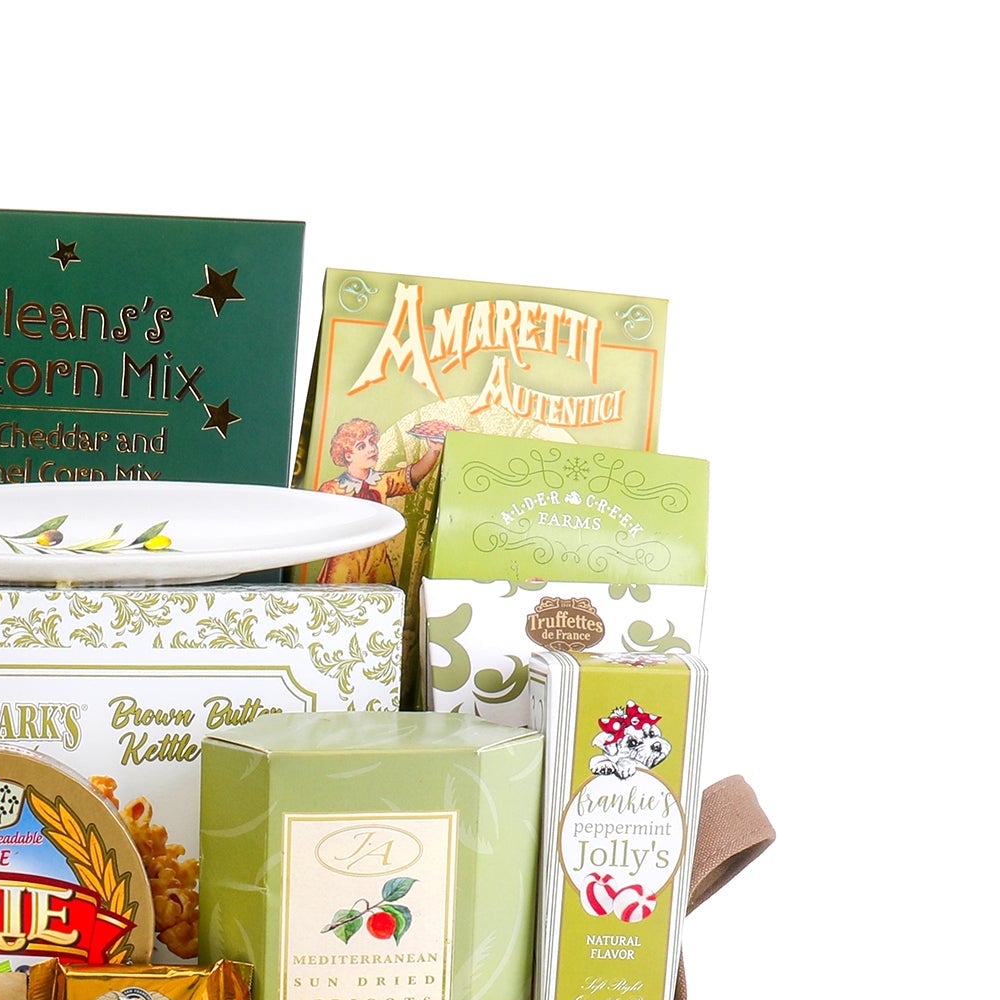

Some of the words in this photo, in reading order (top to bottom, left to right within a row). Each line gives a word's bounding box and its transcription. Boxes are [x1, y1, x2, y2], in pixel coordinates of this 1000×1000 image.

[347, 282, 602, 402] AMARETTI
[121, 350, 204, 401] Mix
[470, 355, 626, 427] AUTENTICI
[116, 427, 167, 454] and
[38, 461, 107, 482] Corn
[537, 512, 602, 530] FARMS
[528, 611, 604, 633] Truffettes
[542, 629, 554, 639] de
[556, 630, 591, 640] France
[108, 696, 195, 729] Brown
[203, 696, 282, 729] Butt
[119, 731, 202, 766] Kettle
[577, 786, 677, 818] frankie's
[573, 821, 672, 838] peppermint
[573, 839, 669, 876] Jolly's
[586, 935, 641, 947] NATURAL
[293, 953, 438, 966] MEDITERRANEAN
[590, 949, 635, 960] FLAVOR
[294, 977, 338, 988] SUN
[358, 975, 435, 987] DRIED
